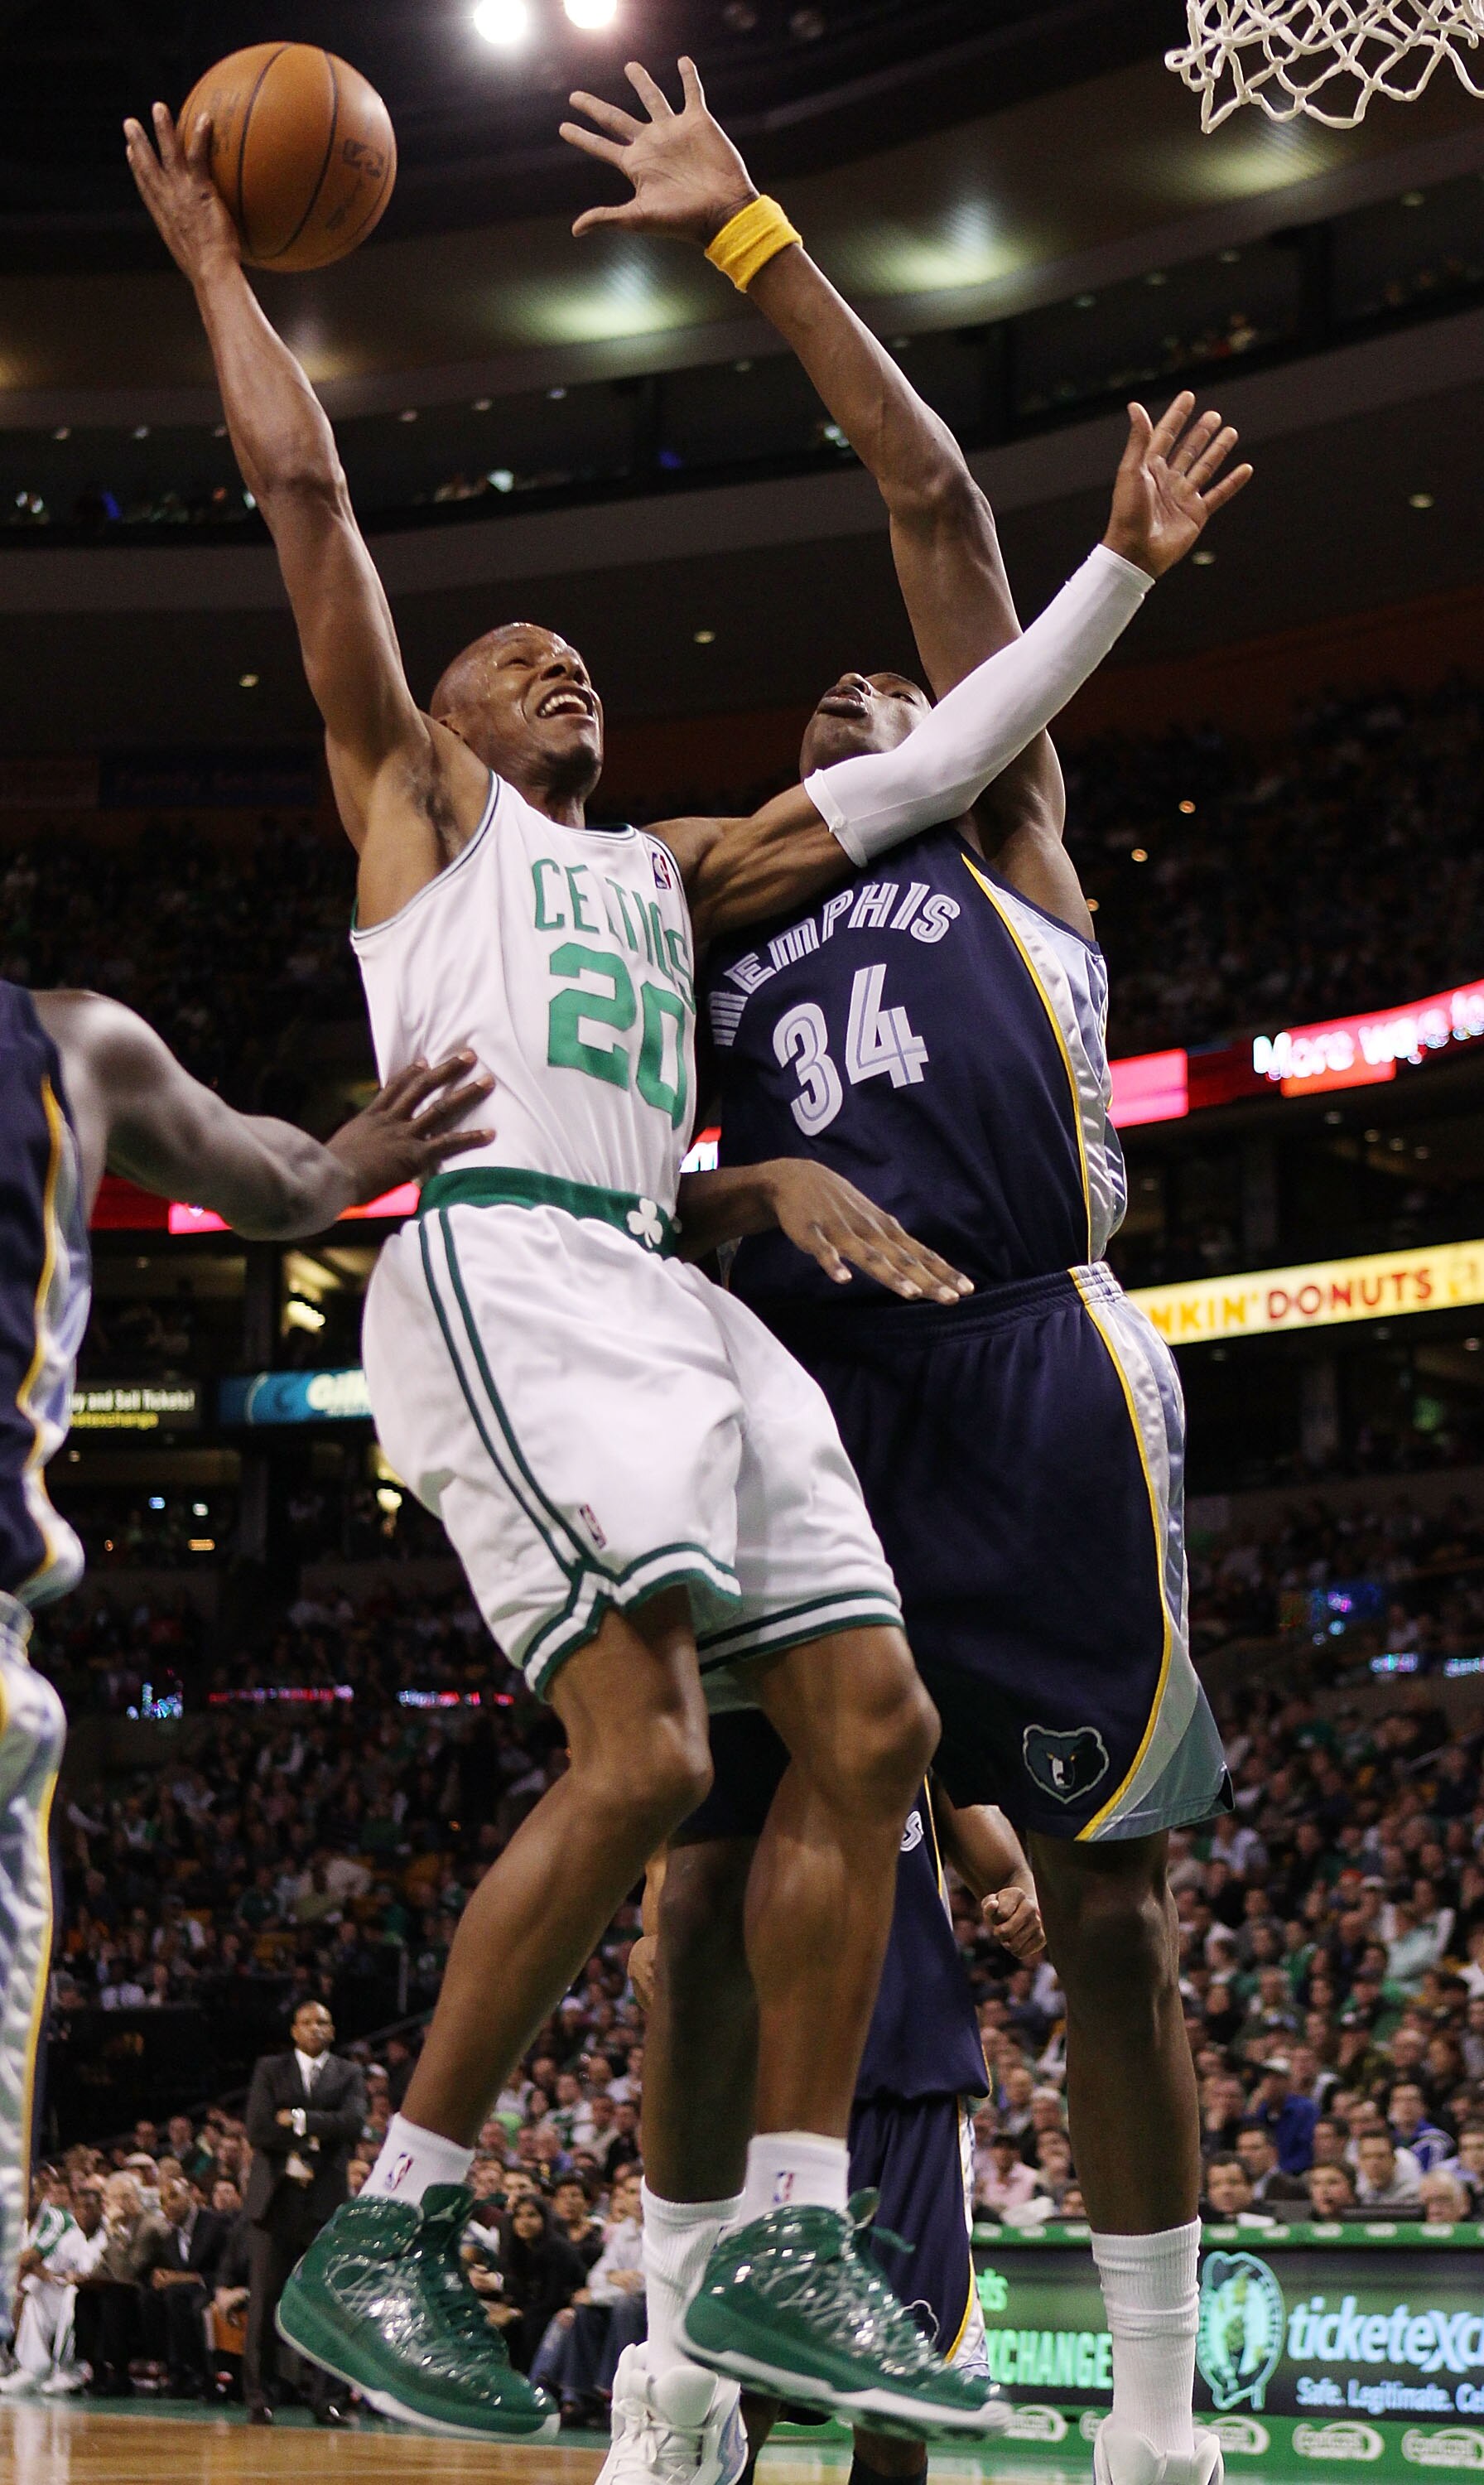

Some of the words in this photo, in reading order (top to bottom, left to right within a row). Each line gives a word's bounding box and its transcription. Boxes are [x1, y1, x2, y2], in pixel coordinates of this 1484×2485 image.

[547, 942, 689, 1130] 20
[709, 881, 961, 1046] MEMPHIS
[773, 963, 929, 1136] 34
[1267, 1267, 1433, 1322] DONUTS
